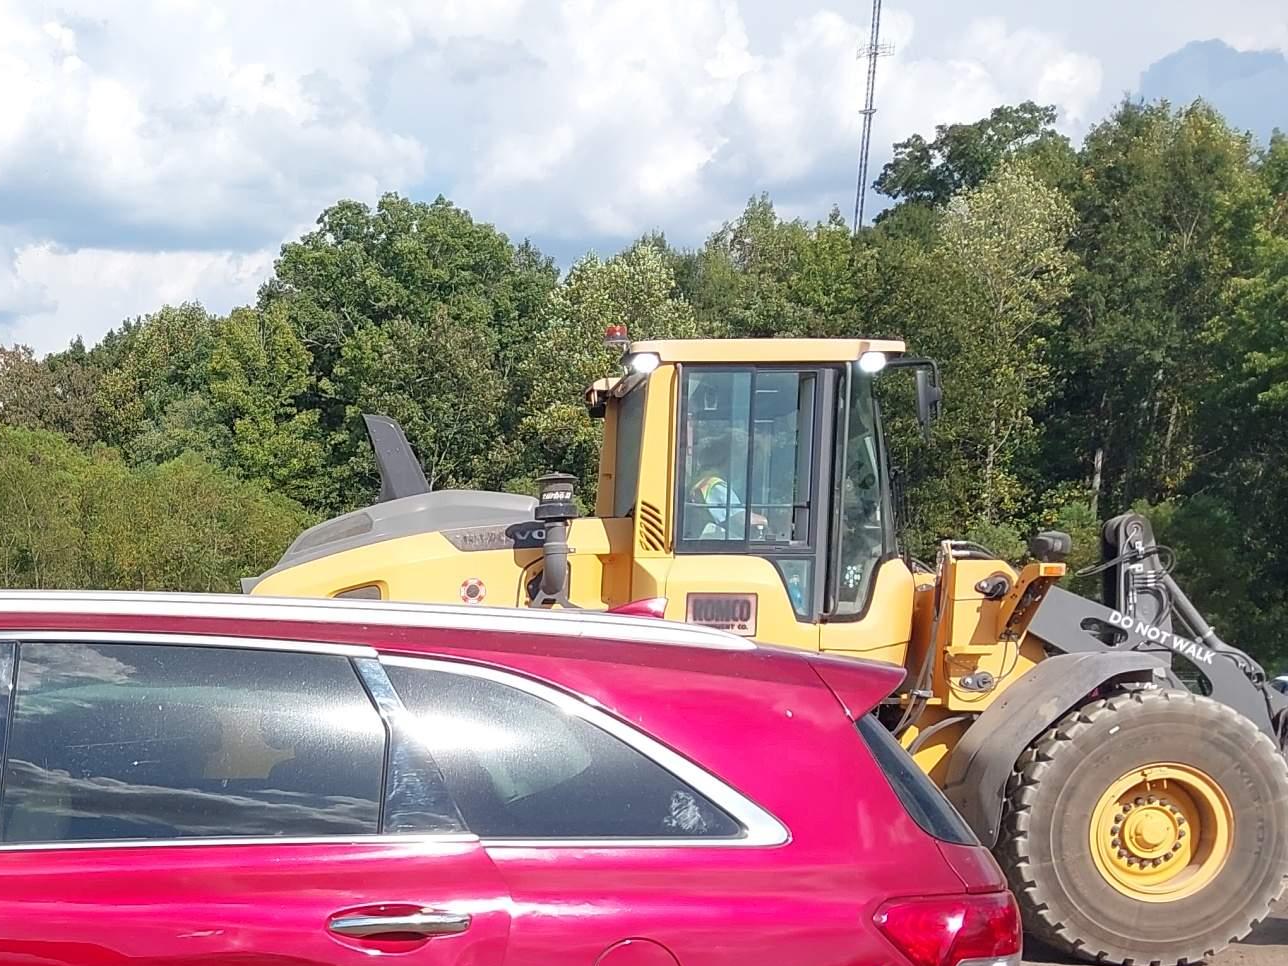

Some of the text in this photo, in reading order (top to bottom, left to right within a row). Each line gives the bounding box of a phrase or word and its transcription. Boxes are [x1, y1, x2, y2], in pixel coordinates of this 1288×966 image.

[1109, 610, 1217, 665] DO NOT WALK
